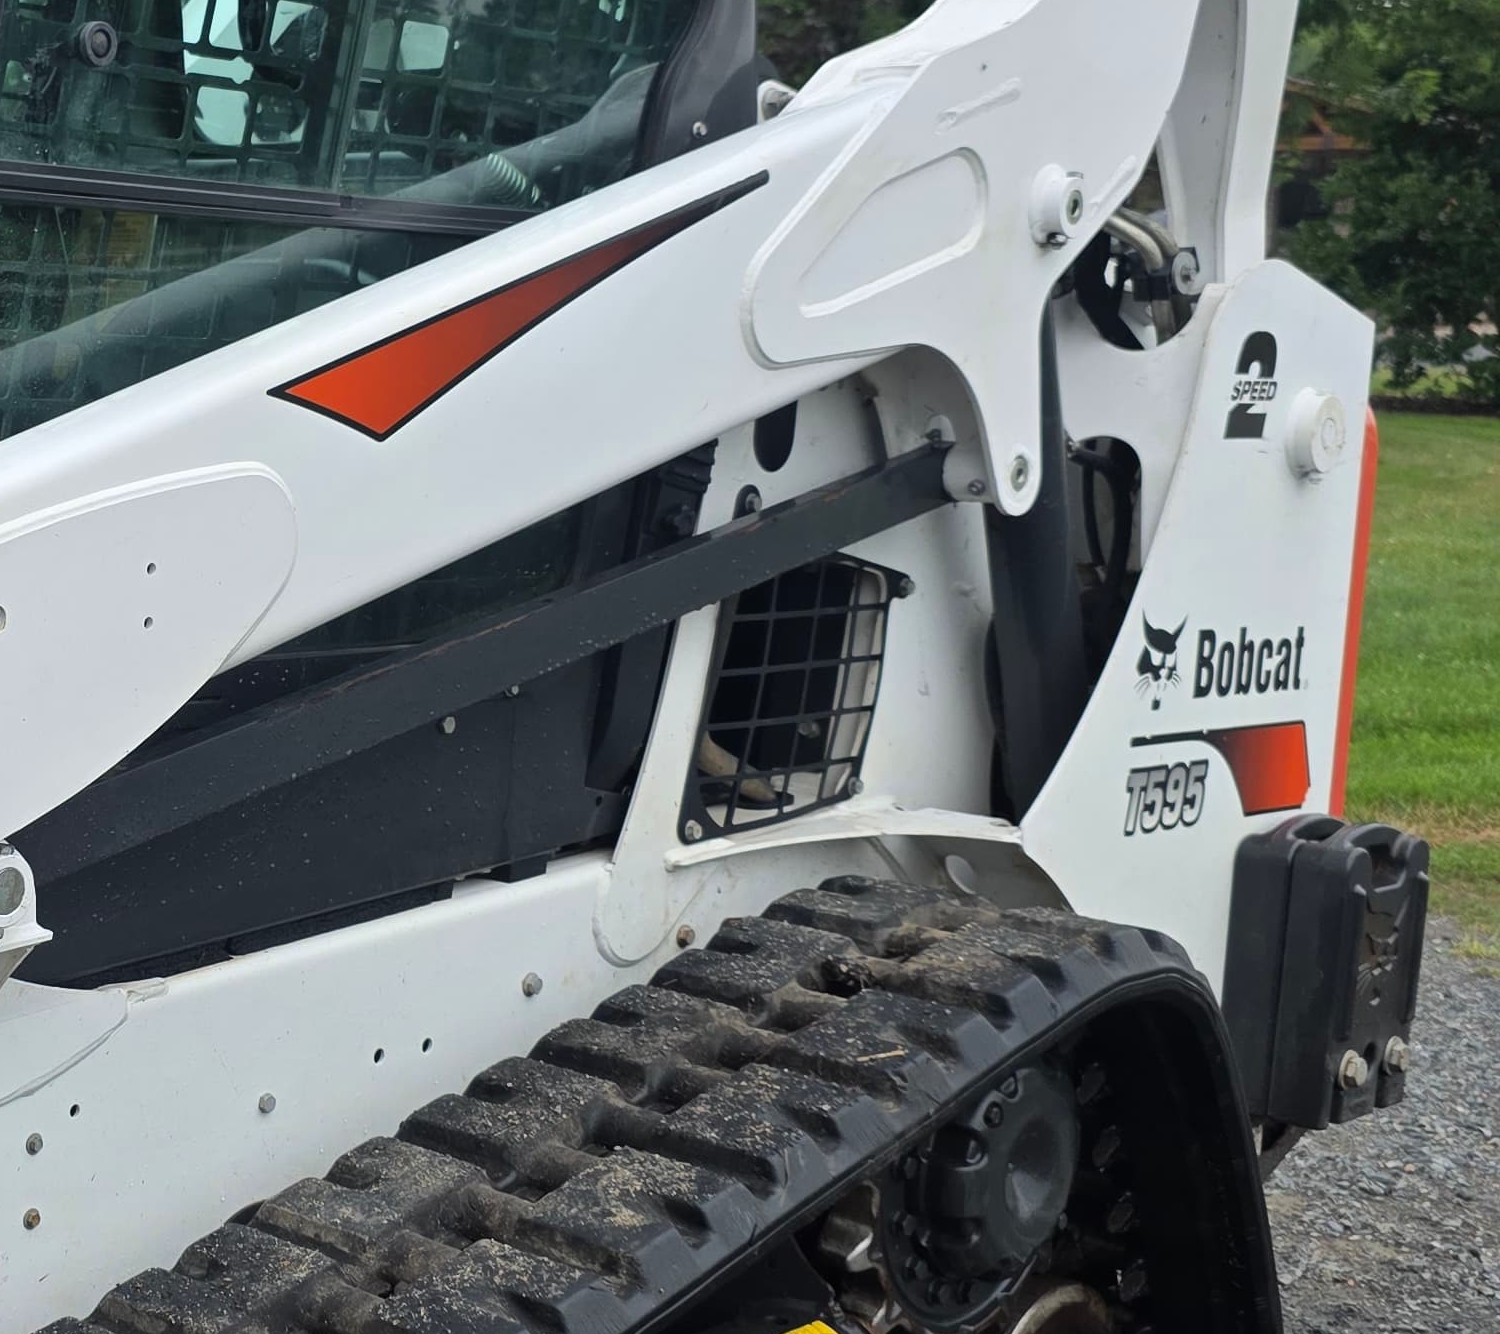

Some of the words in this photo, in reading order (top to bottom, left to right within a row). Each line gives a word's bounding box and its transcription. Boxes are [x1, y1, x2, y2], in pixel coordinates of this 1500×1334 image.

[1230, 379, 1278, 402] SPEED
[1192, 625, 1306, 699] Bobcat
[1123, 758, 1210, 837] T595
